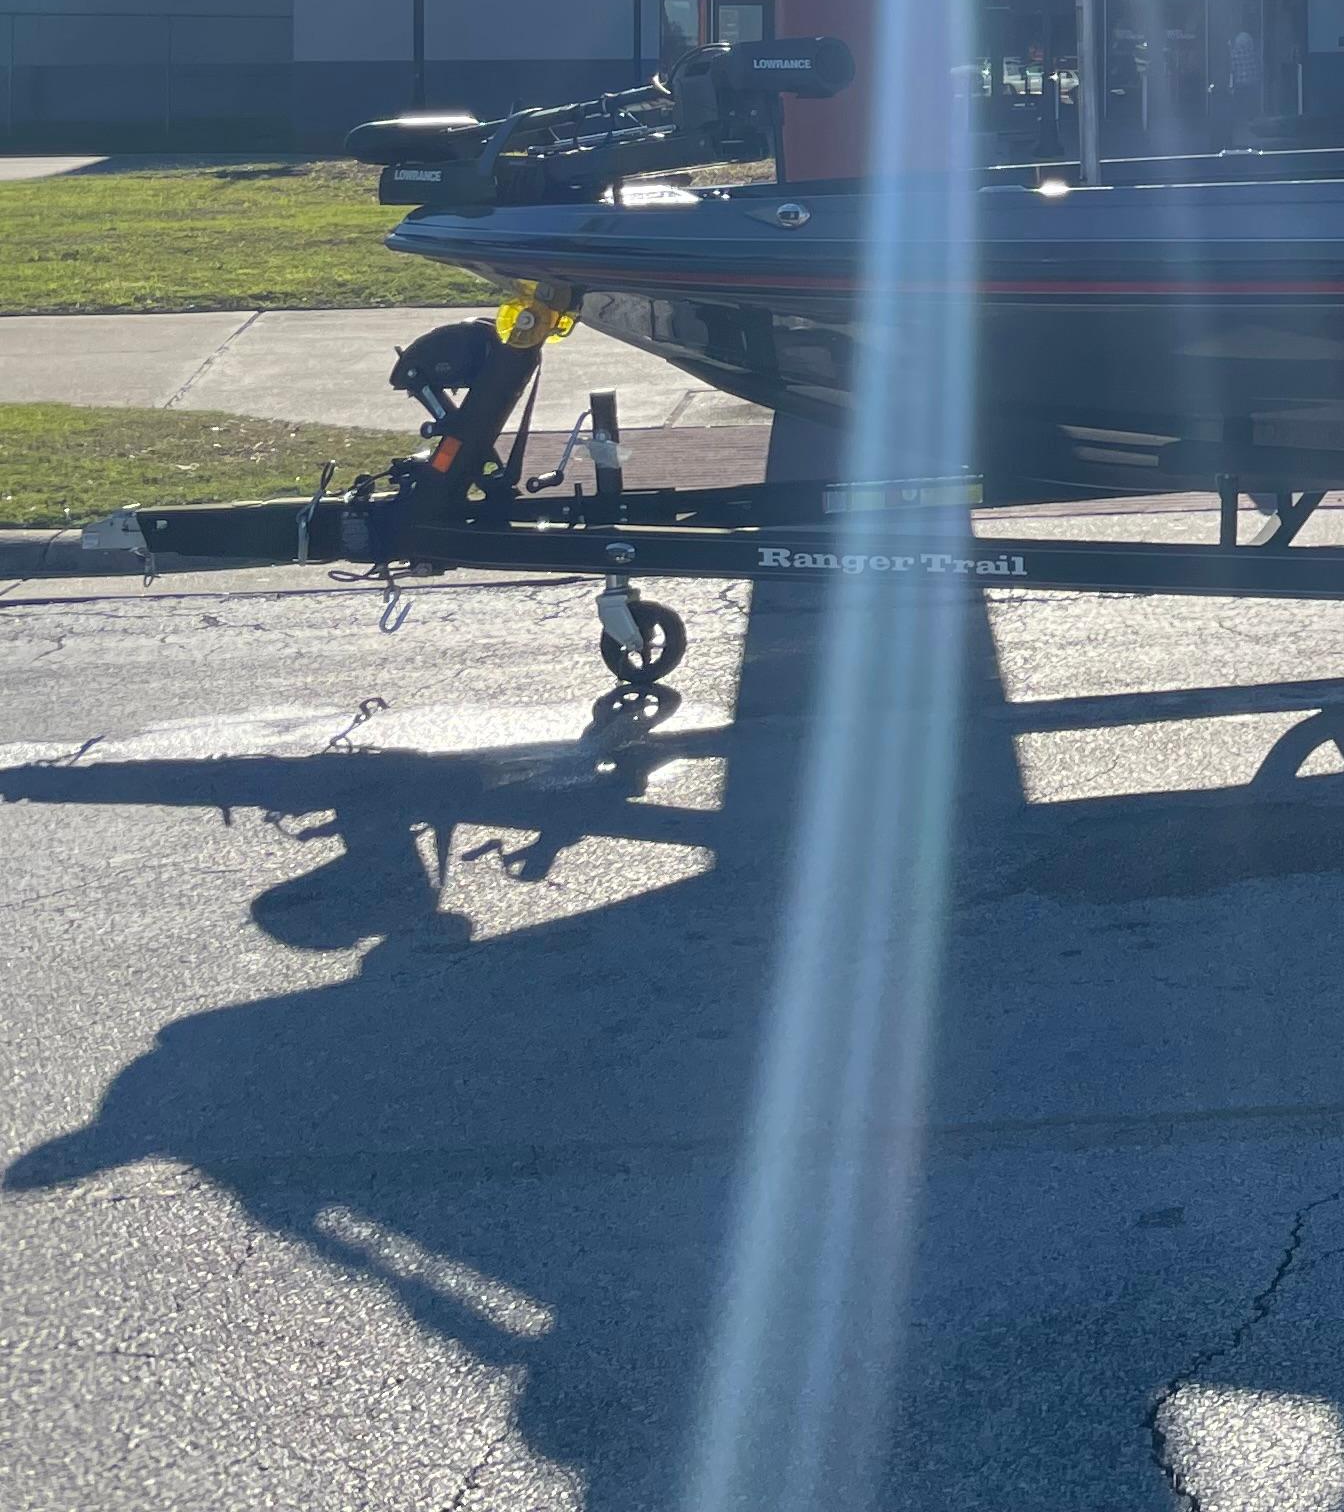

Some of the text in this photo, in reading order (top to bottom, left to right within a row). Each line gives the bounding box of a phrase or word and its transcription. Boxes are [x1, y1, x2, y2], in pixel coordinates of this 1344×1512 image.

[753, 59, 811, 69] LOWRANCE
[758, 548, 1028, 576] Ranger Trail
